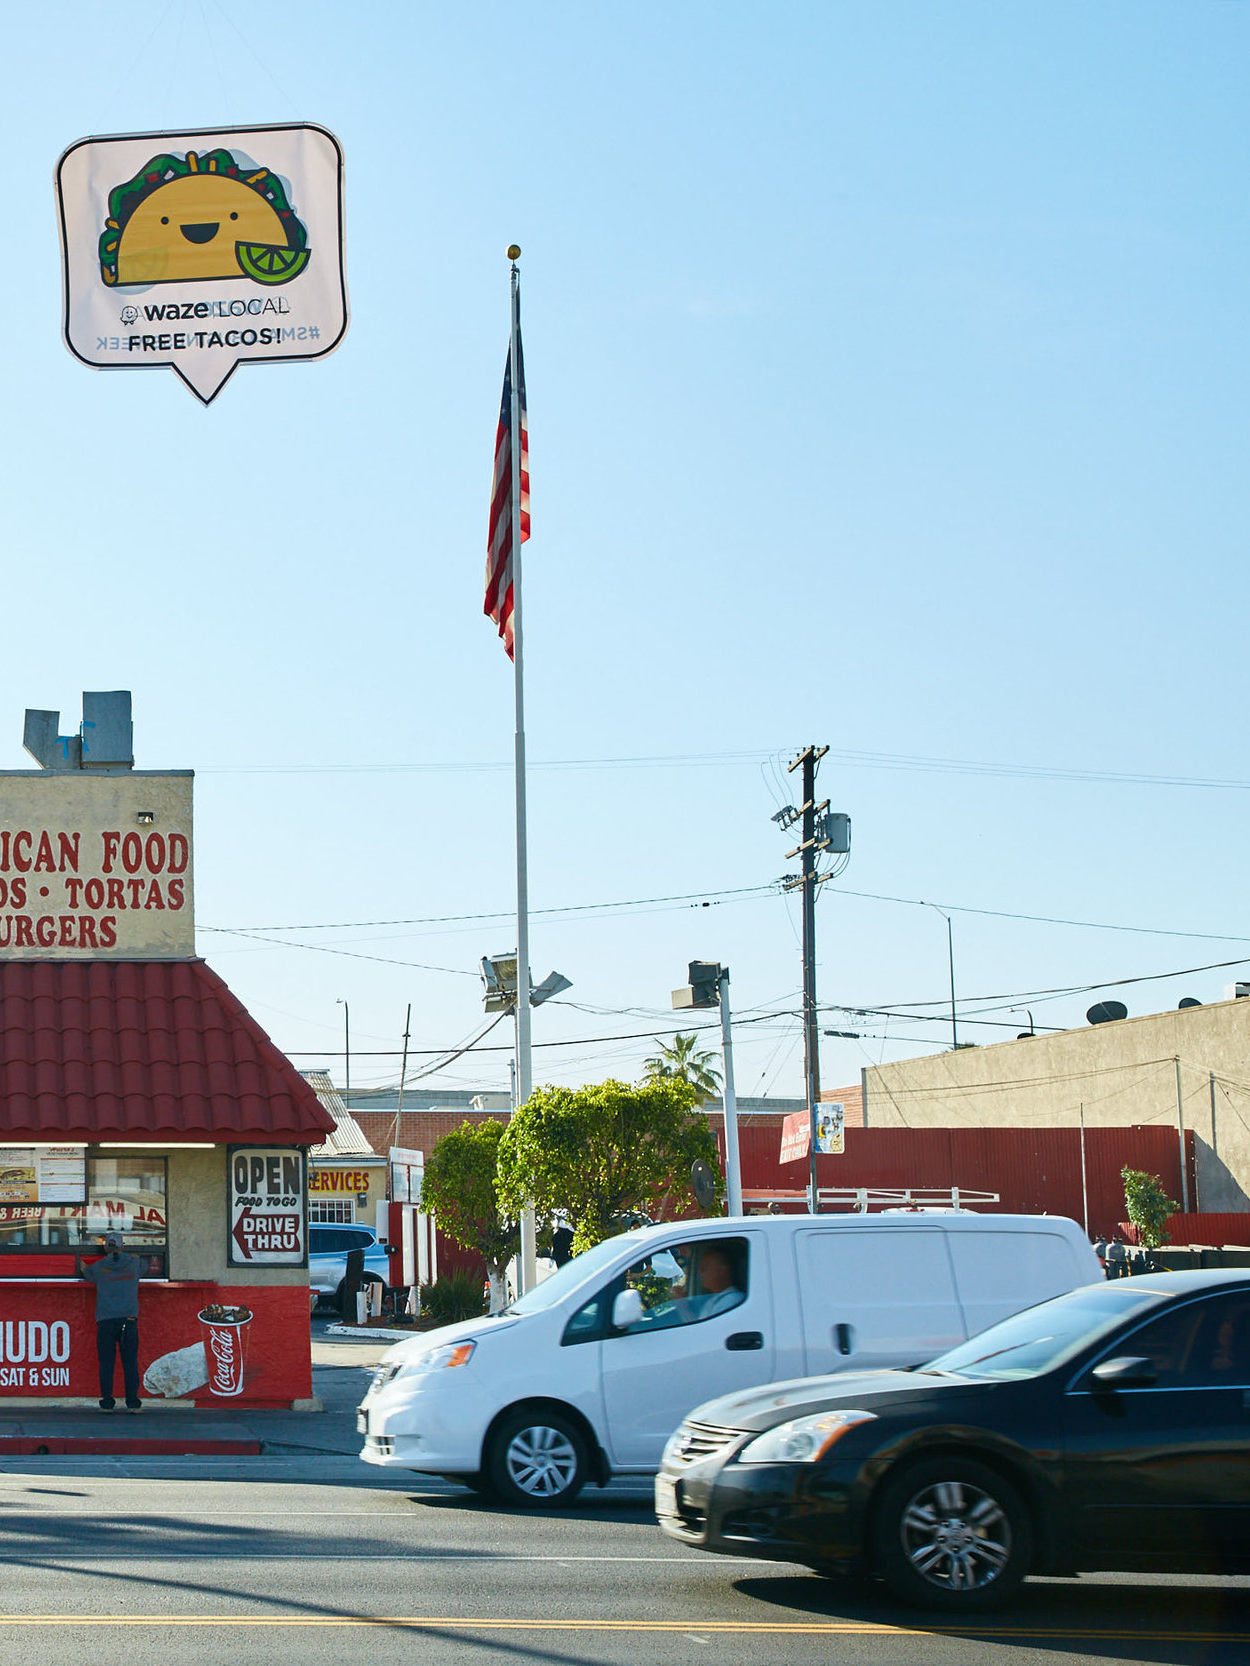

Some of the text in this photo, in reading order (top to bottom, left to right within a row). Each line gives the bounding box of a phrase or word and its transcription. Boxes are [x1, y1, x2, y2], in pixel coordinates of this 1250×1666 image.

[144, 297, 290, 321] waze LOCAL
[128, 332, 186, 352] FREE
[195, 327, 282, 349] TACOS!
[102, 831, 189, 875] FOOD
[64, 878, 185, 911] TORTAS
[234, 1155, 300, 1195] OPEN
[309, 1171, 370, 1191] ERVICES
[235, 1196, 262, 1207] FOOD
[243, 1217, 295, 1232] DRIVE
[244, 1234, 295, 1249] THRU
[209, 1328, 234, 1394] Coca-Cola
[0, 1368, 26, 1387] SAT
[29, 1368, 39, 1386] &
[41, 1368, 70, 1387] SUN
